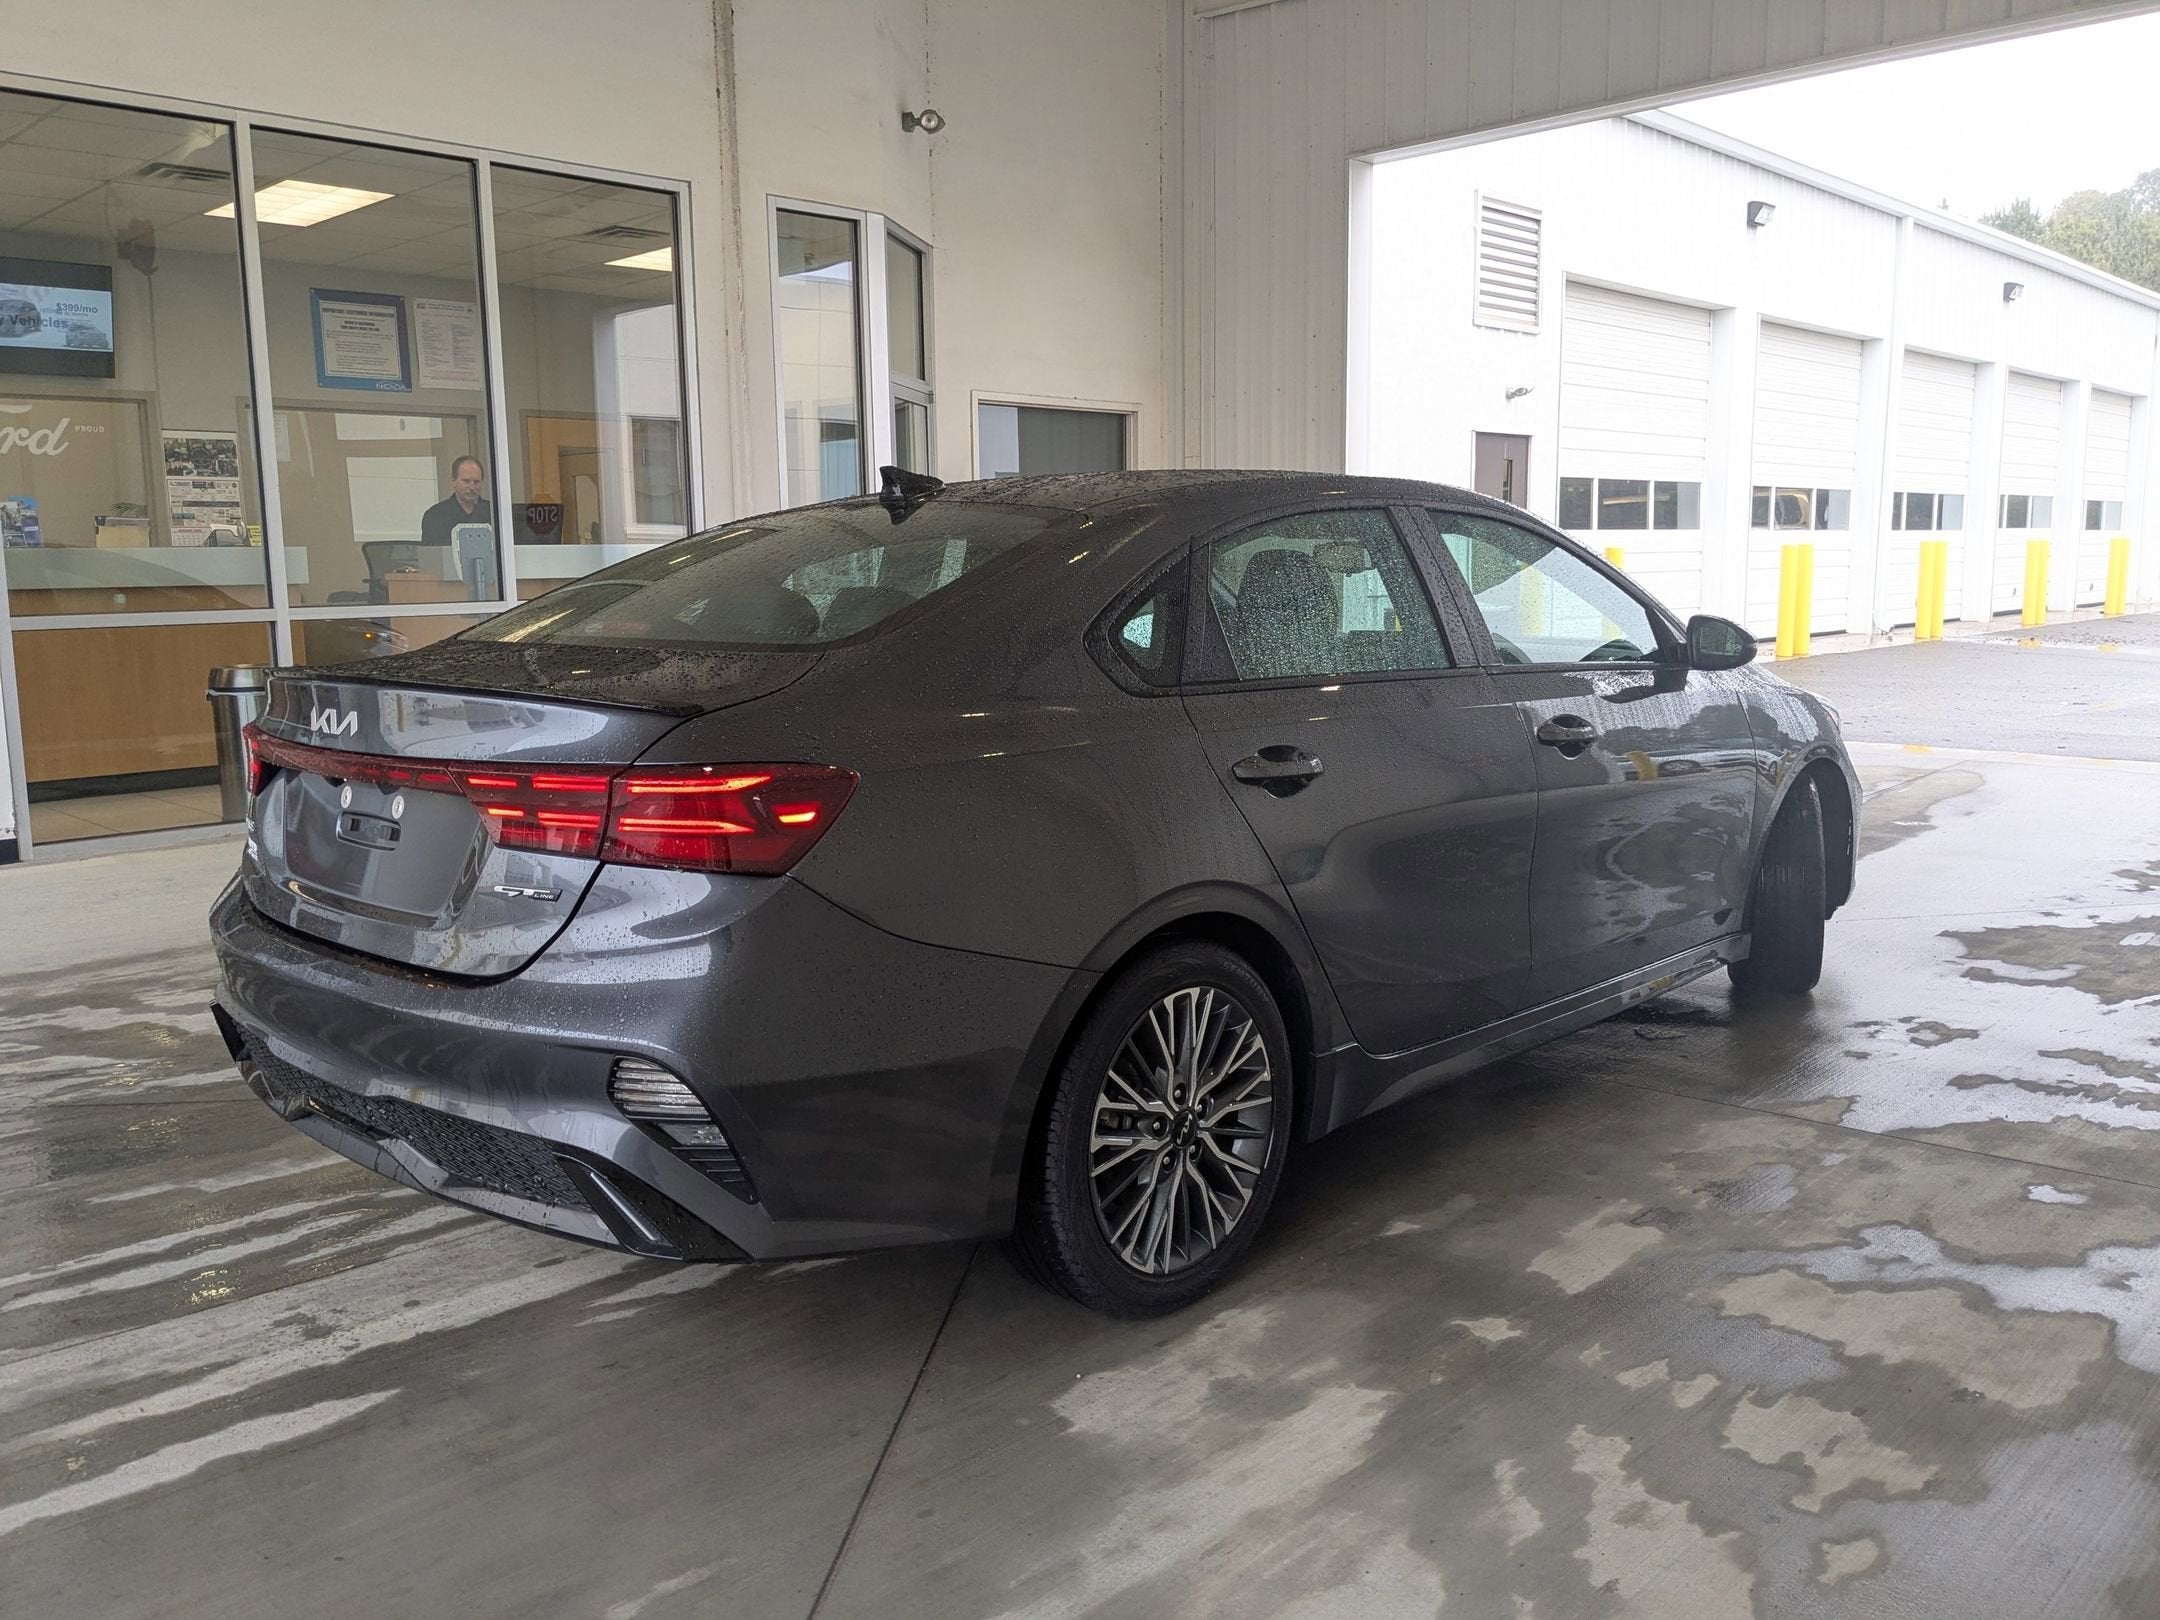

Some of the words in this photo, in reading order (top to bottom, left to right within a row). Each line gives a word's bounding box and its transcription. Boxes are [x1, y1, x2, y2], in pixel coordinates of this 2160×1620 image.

[56, 302, 98, 314] $399/mo
[9, 314, 70, 329] Vehicles
[0, 404, 71, 456] rd
[74, 425, 105, 433] PROUD
[310, 705, 358, 737] KIA
